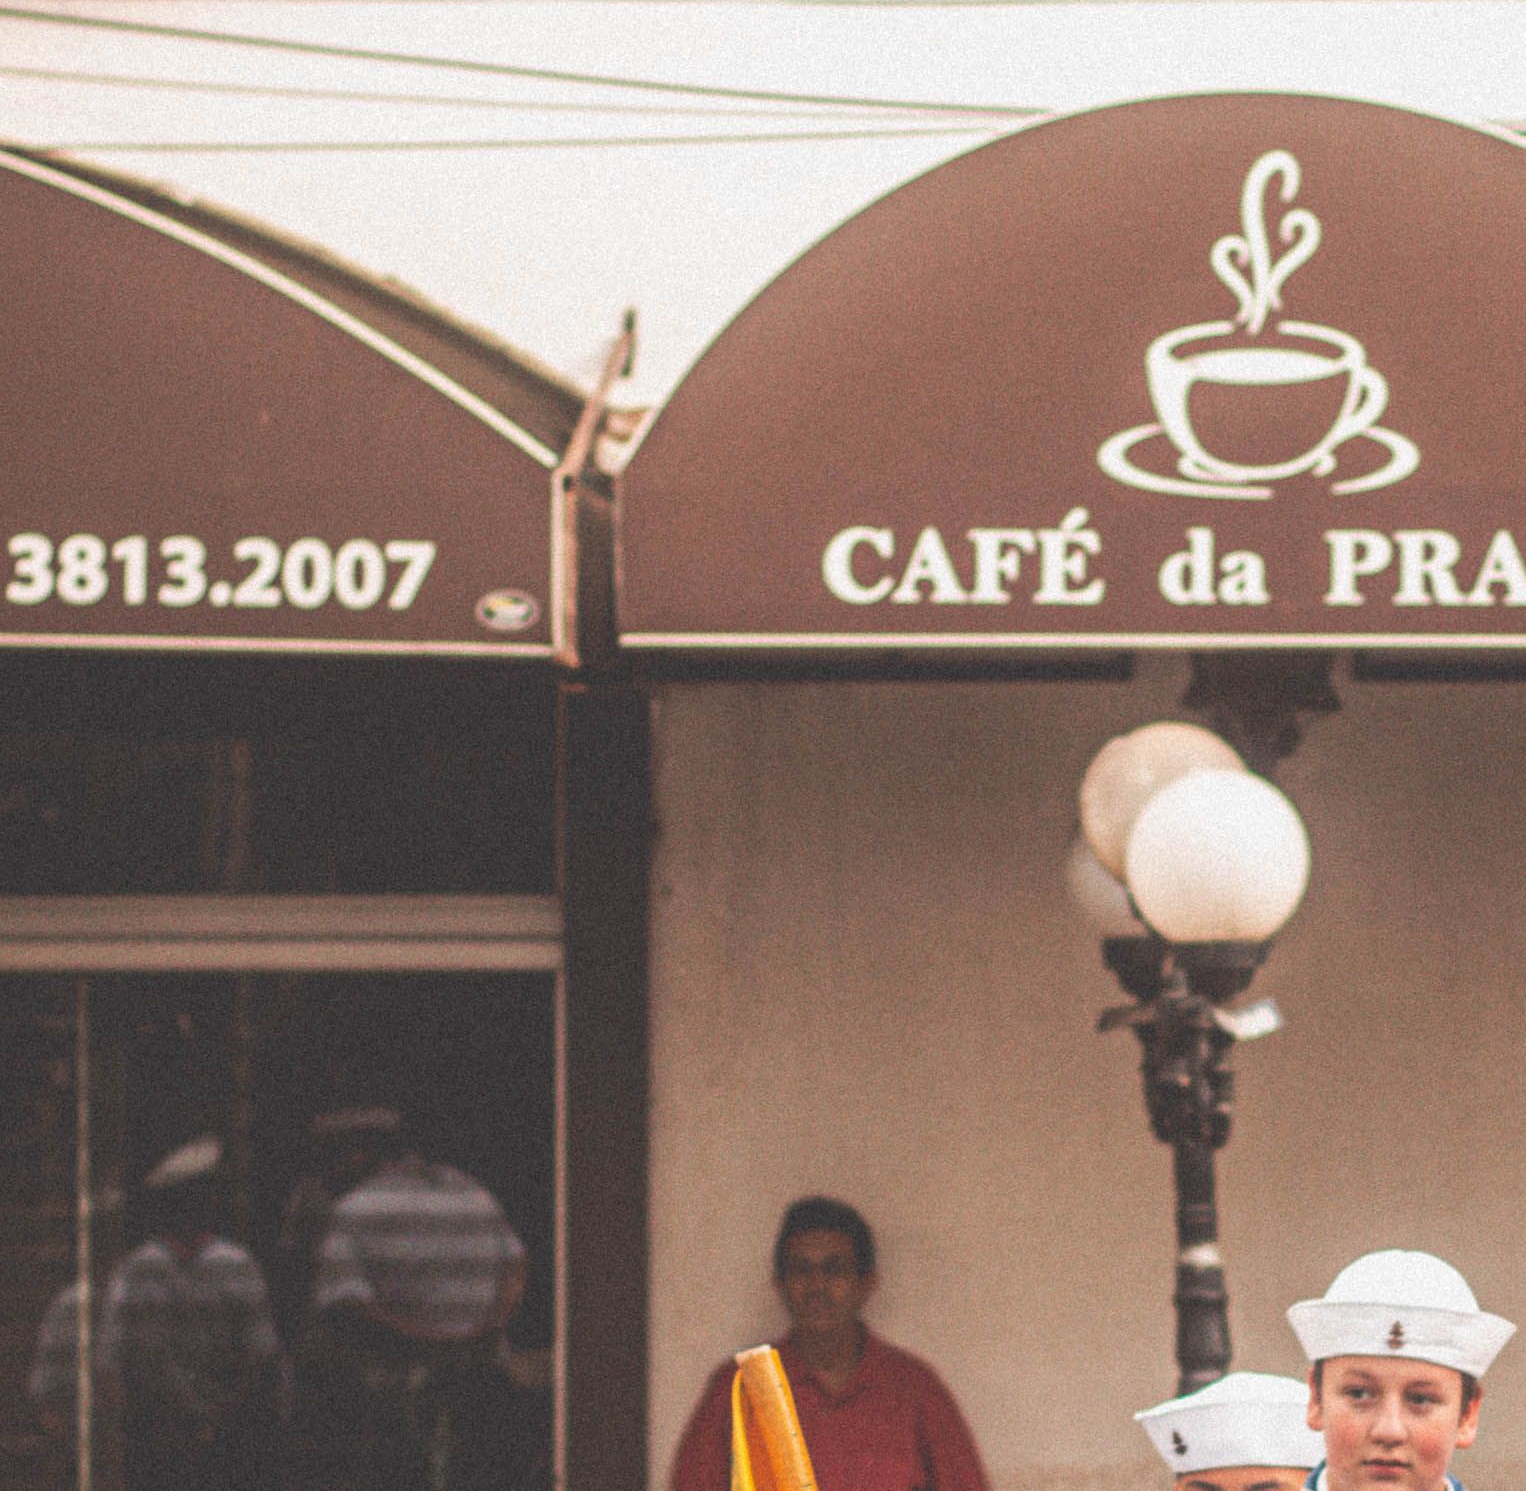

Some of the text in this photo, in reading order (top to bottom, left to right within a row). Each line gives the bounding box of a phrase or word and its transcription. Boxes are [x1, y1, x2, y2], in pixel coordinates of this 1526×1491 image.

[5, 532, 438, 611] 3813.2007
[821, 507, 1106, 606] CAFÉ
[1159, 527, 1269, 606] da
